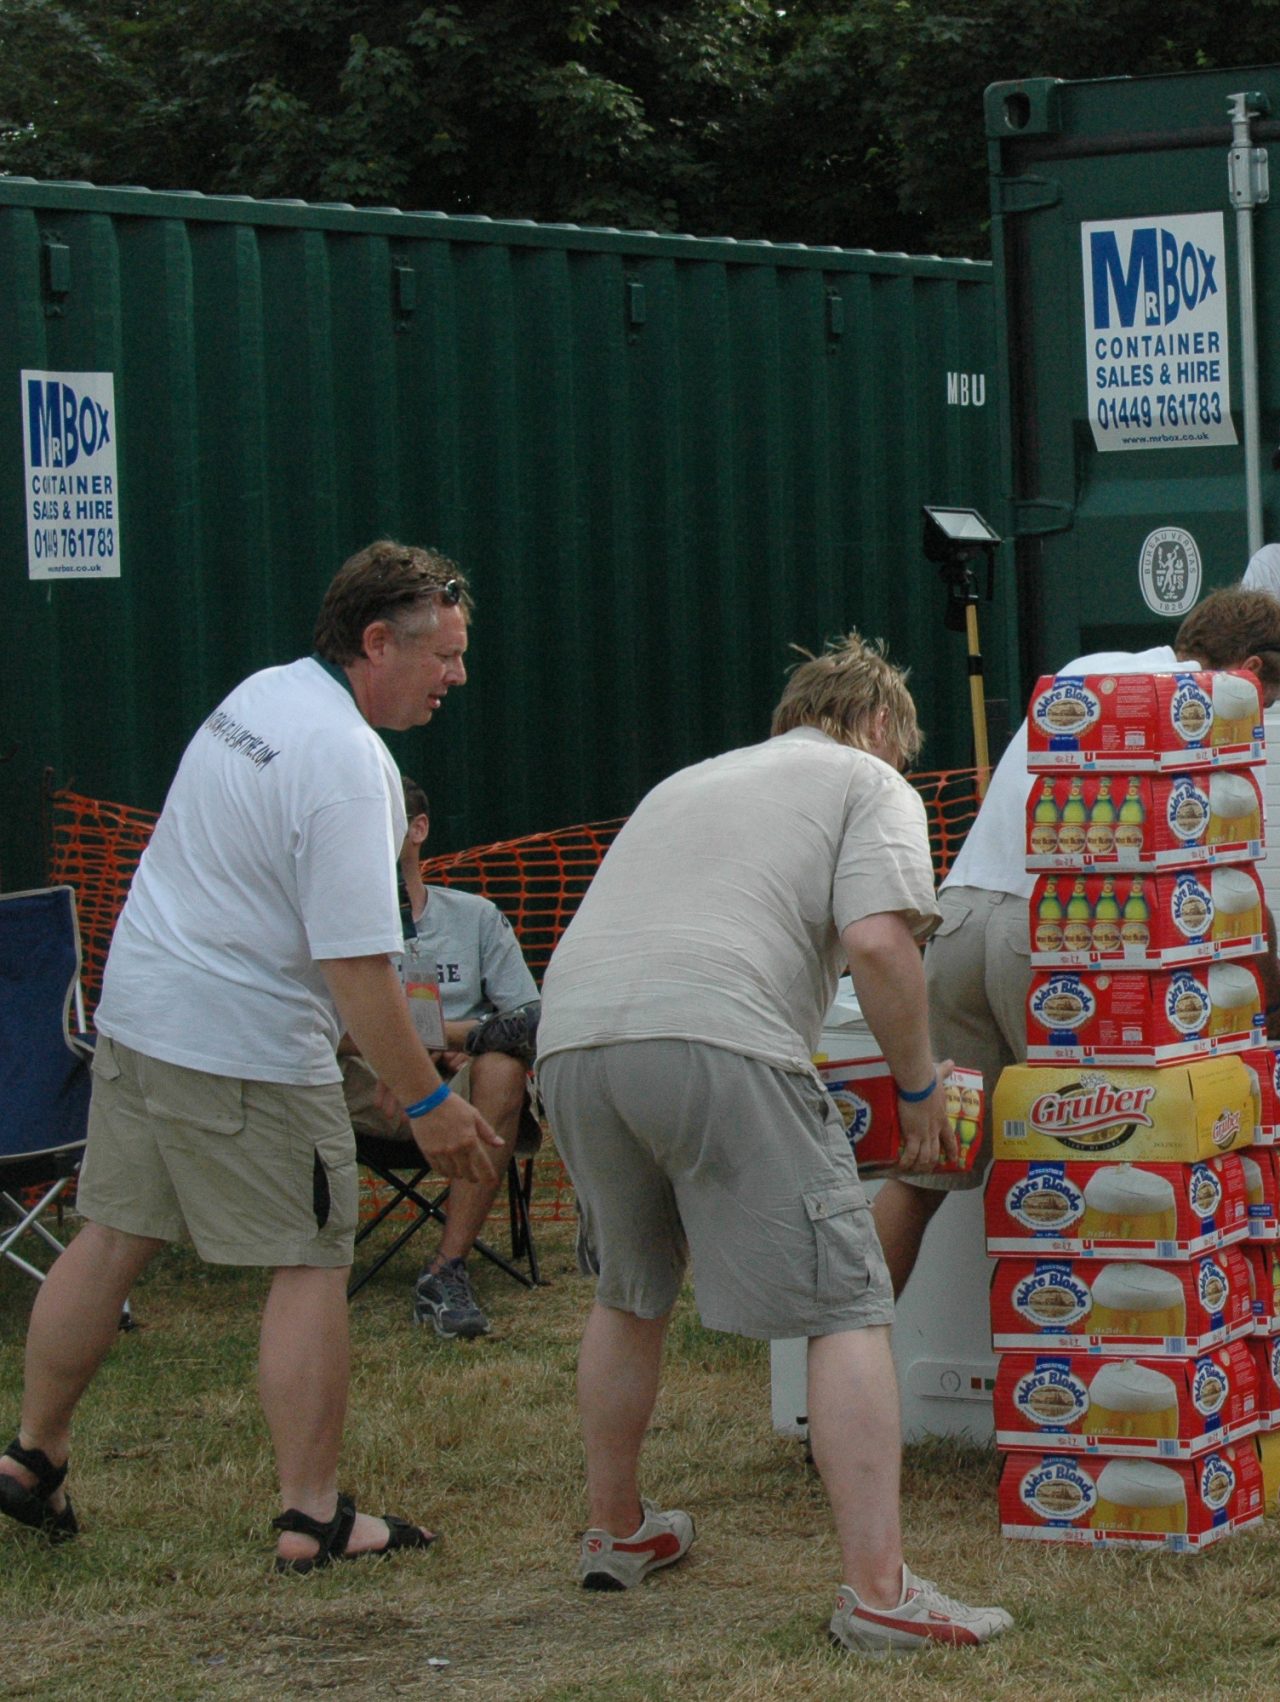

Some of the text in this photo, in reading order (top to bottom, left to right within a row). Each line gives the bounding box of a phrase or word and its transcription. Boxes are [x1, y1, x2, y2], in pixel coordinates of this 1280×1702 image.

[1095, 331, 1220, 360] CONTAINER
[1096, 360, 1220, 388] SALES & HIRE
[1097, 391, 1222, 431] 01449 761783
[1122, 432, 1209, 445] www.mrbox.co.uk
[62, 502, 71, 520] &
[77, 500, 113, 520] HIRE
[62, 527, 114, 558] 761783
[1065, 688, 1097, 717] Blonde
[1061, 982, 1092, 1013] Blonde
[1031, 1086, 1153, 1125] Gruber
[1011, 1177, 1081, 1212] Bière Blonde
[1017, 1273, 1088, 1308] Bière Blonde
[1017, 1372, 1087, 1408] Bière Blonde
[1024, 1465, 1094, 1502] Bière Blonde
